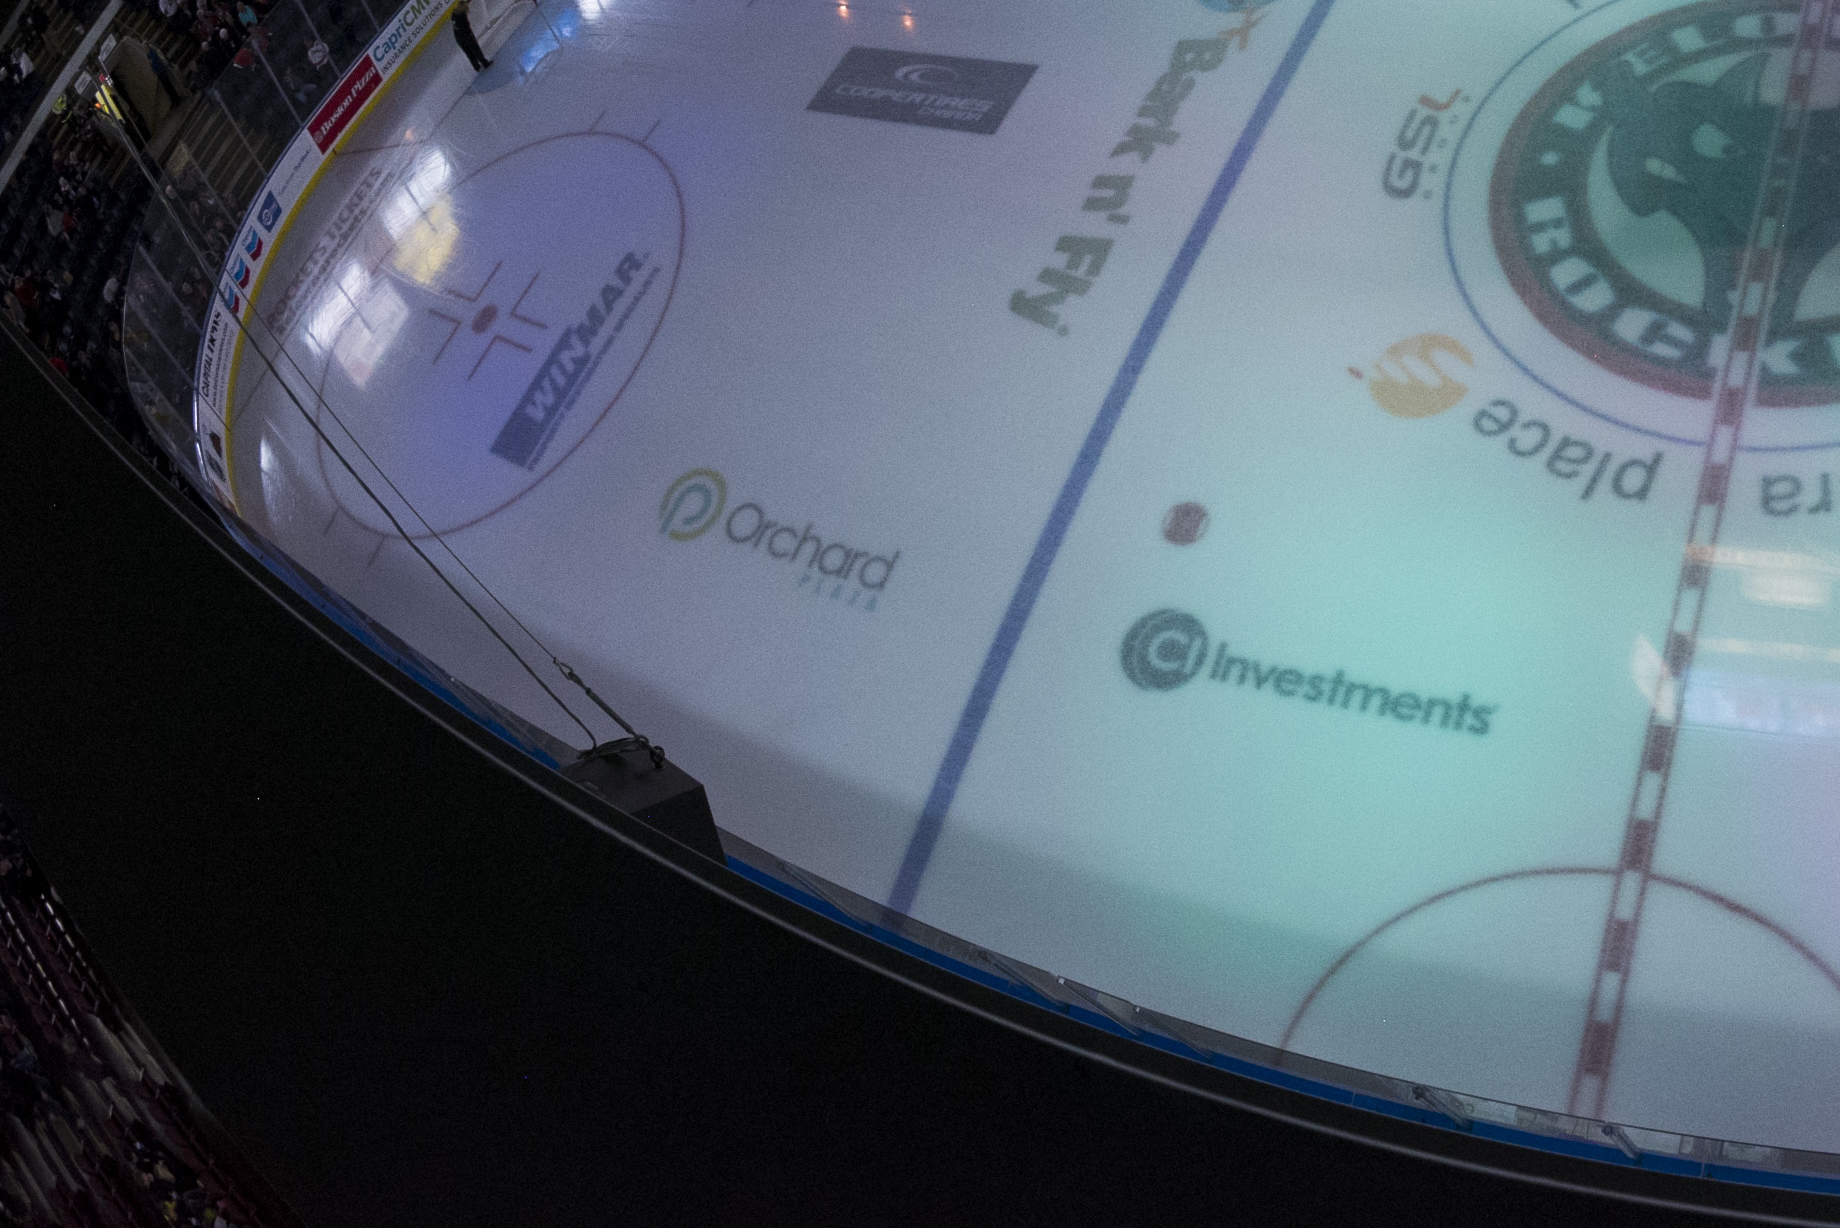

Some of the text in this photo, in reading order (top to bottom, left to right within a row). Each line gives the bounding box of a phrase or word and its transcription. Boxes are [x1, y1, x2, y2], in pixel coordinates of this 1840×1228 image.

[380, 1, 444, 75] INSURANCE SOLUTIONS
[320, 65, 377, 136] Boston Pizza
[1381, 88, 1462, 201] GSL
[267, 239, 330, 331] ROCKETS
[325, 166, 384, 238] TICKETS
[1008, 234, 1115, 332] Fly
[200, 346, 217, 398] CAPITAL
[523, 251, 645, 424] WINMAR
[1472, 395, 1665, 504] place
[725, 502, 900, 592] Orchard
[1208, 641, 1495, 738] Investments
